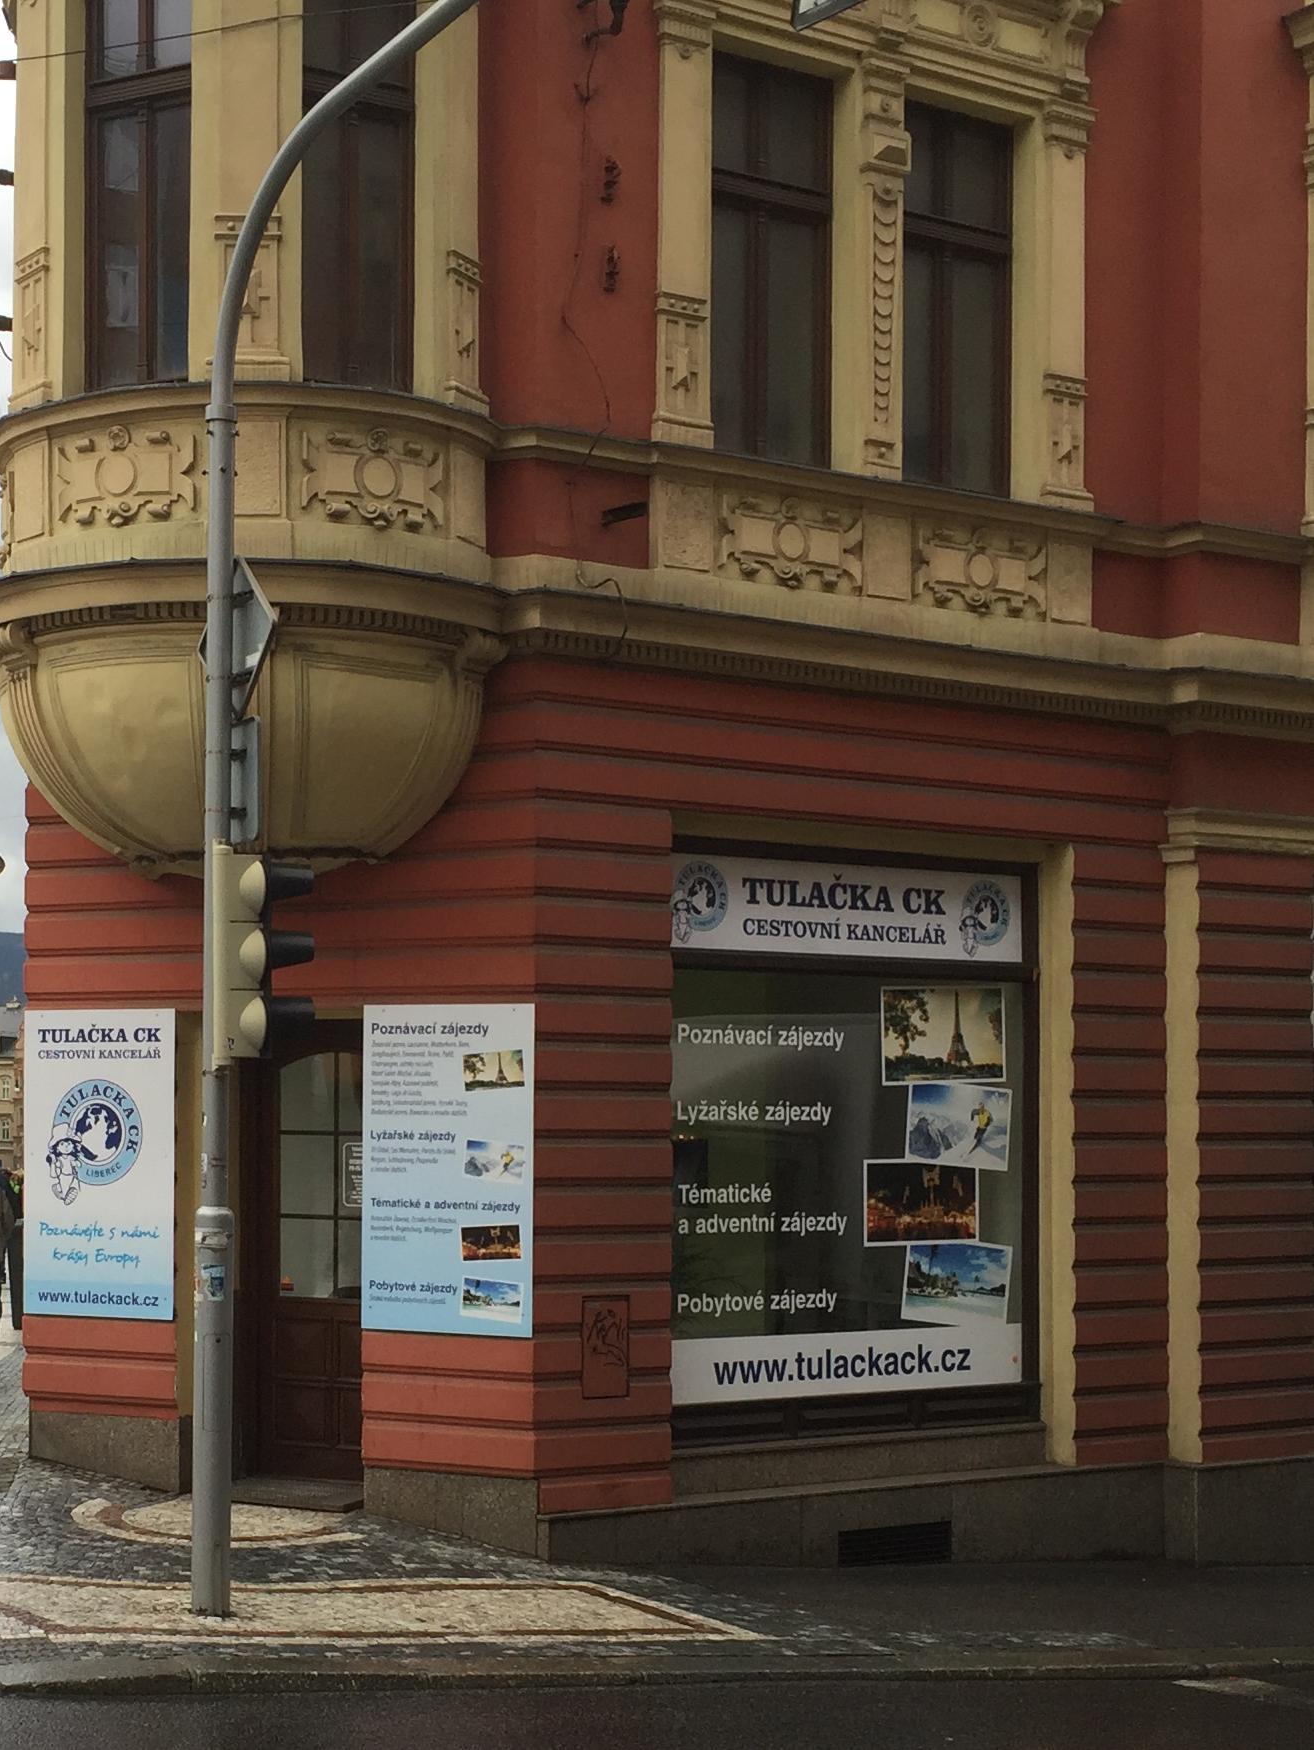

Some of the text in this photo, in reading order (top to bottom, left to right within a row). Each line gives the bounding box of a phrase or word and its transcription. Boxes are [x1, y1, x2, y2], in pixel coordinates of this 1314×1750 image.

[742, 873, 895, 914] TULAČKA
[901, 886, 947, 916] CK
[742, 918, 948, 946] CESTOVNÍ KANCELÁŘ
[37, 1024, 161, 1043] TULAČKA CK
[371, 1022, 489, 1038] Poznávací zájezdy
[677, 1023, 845, 1052] Poznávací zájezdy
[37, 1046, 161, 1060] CESTOVNÍ KANCELÁŘ
[676, 1100, 832, 1127] Lyžařské zájezdy
[125, 1124, 140, 1154] CK
[370, 1130, 457, 1144] Lyžařské zájezdy
[85, 1162, 122, 1178] LIBEREC
[677, 1182, 773, 1205] Tématické
[370, 1197, 521, 1215] Tématické a adventní zájezdy
[39, 1220, 104, 1242] Poznávejte
[120, 1225, 160, 1240] námi
[677, 1211, 848, 1238] a adventní zájezdy
[52, 1247, 141, 1269] krásy Evropy
[38, 1290, 160, 1307] www.tulackack.cz
[369, 1279, 458, 1296] Pobytové zájezdy
[676, 1288, 838, 1318] Pobytové zájezdy
[713, 1344, 972, 1386] www.tulackack.cz
